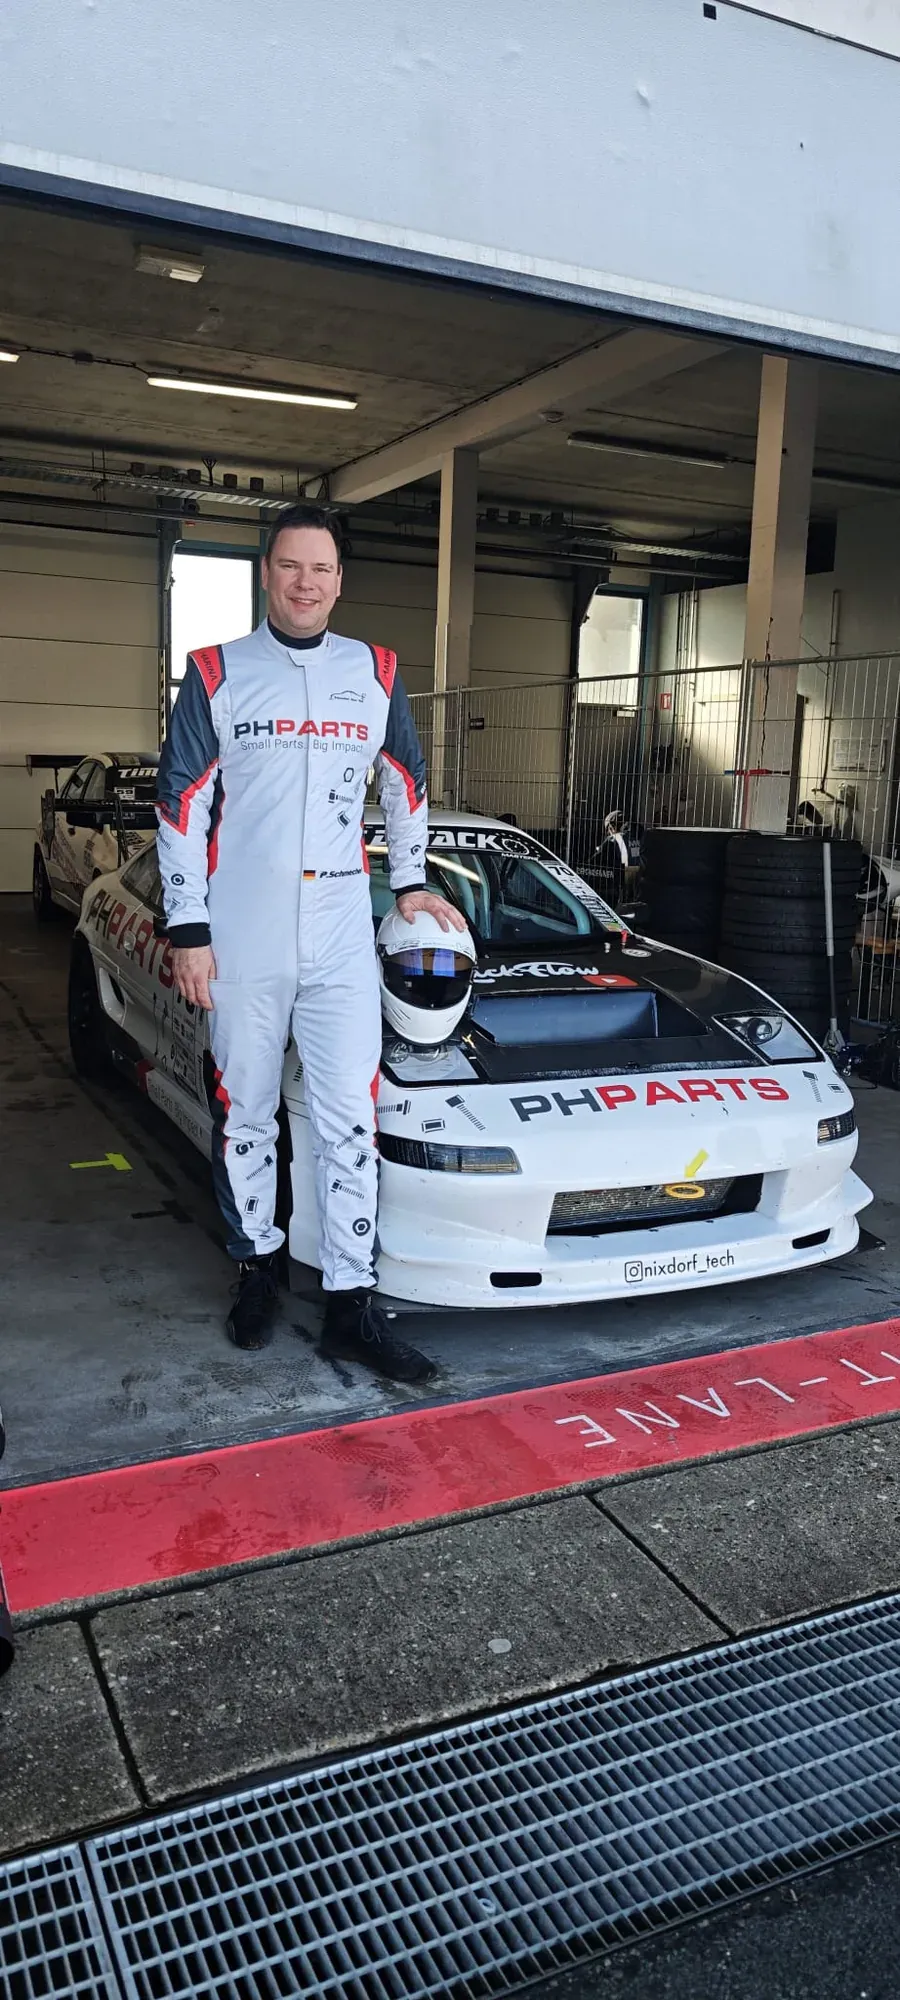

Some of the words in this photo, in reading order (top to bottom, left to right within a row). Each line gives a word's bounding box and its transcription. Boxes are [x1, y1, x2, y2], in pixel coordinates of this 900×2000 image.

[233, 719, 369, 742] PHPARTS
[240, 740, 271, 751] Small
[312, 740, 329, 753] Big
[332, 741, 364, 754] Impact
[85, 888, 175, 989] PHPARTS
[509, 1078, 790, 1122] PHPARTS
[644, 1249, 735, 1278] nixdorf_tech
